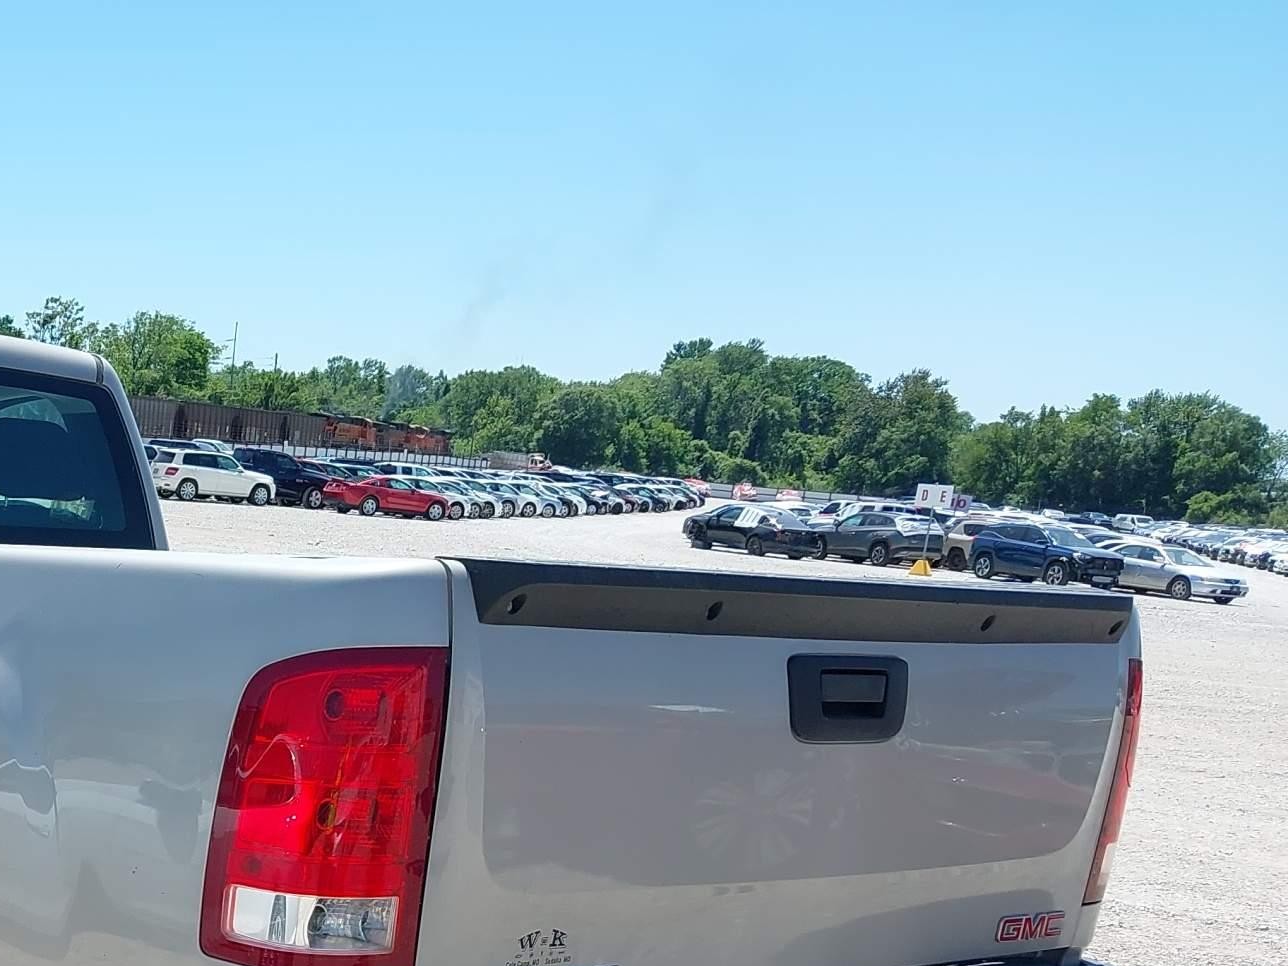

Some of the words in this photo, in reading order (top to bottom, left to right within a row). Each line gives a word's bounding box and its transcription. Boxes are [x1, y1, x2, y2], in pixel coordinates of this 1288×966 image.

[921, 489, 929, 502] D
[940, 490, 947, 502] E
[995, 911, 1065, 943] GMC
